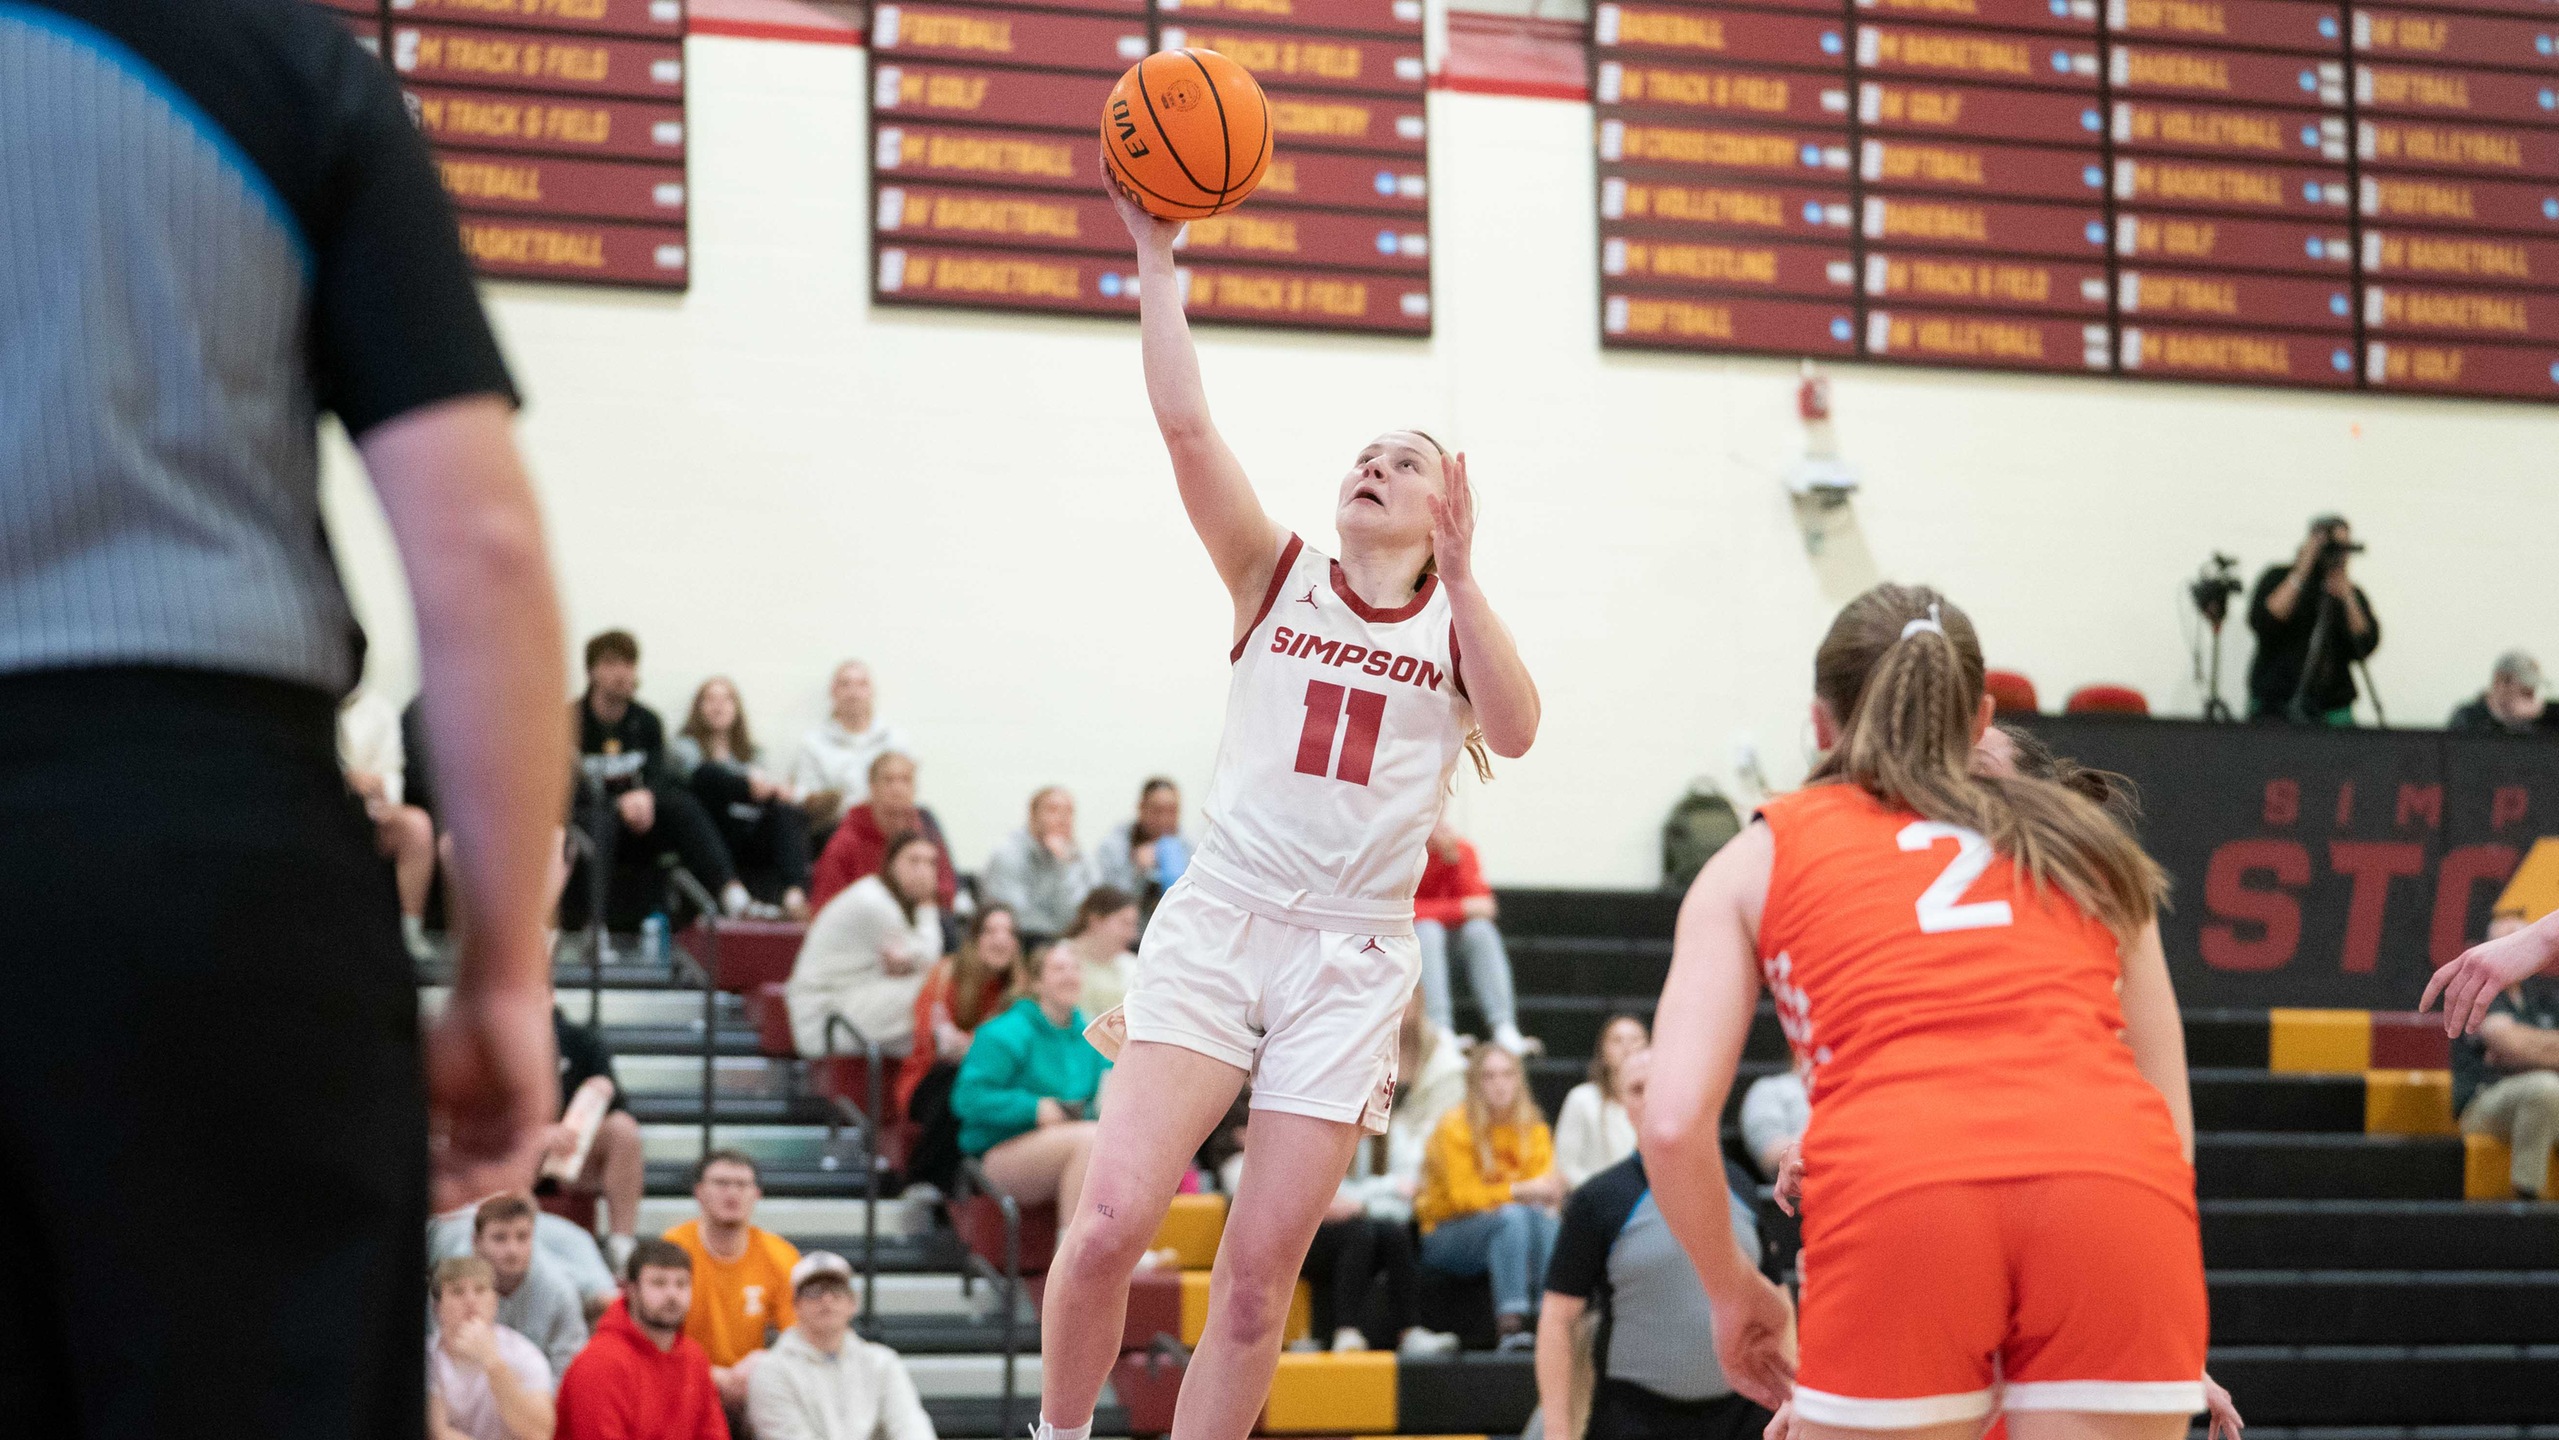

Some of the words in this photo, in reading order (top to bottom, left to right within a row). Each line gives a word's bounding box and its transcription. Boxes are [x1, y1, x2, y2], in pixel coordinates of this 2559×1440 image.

[448, 39, 518, 75] TRACK
[547, 46, 609, 82] FIELD
[448, 100, 519, 137] TRACK
[548, 107, 610, 144] FIELD
[1113, 99, 1150, 159] EVO
[1271, 626, 1443, 691] SIMPSON
[1294, 679, 1387, 786] 11
[1896, 821, 2013, 933] 2
